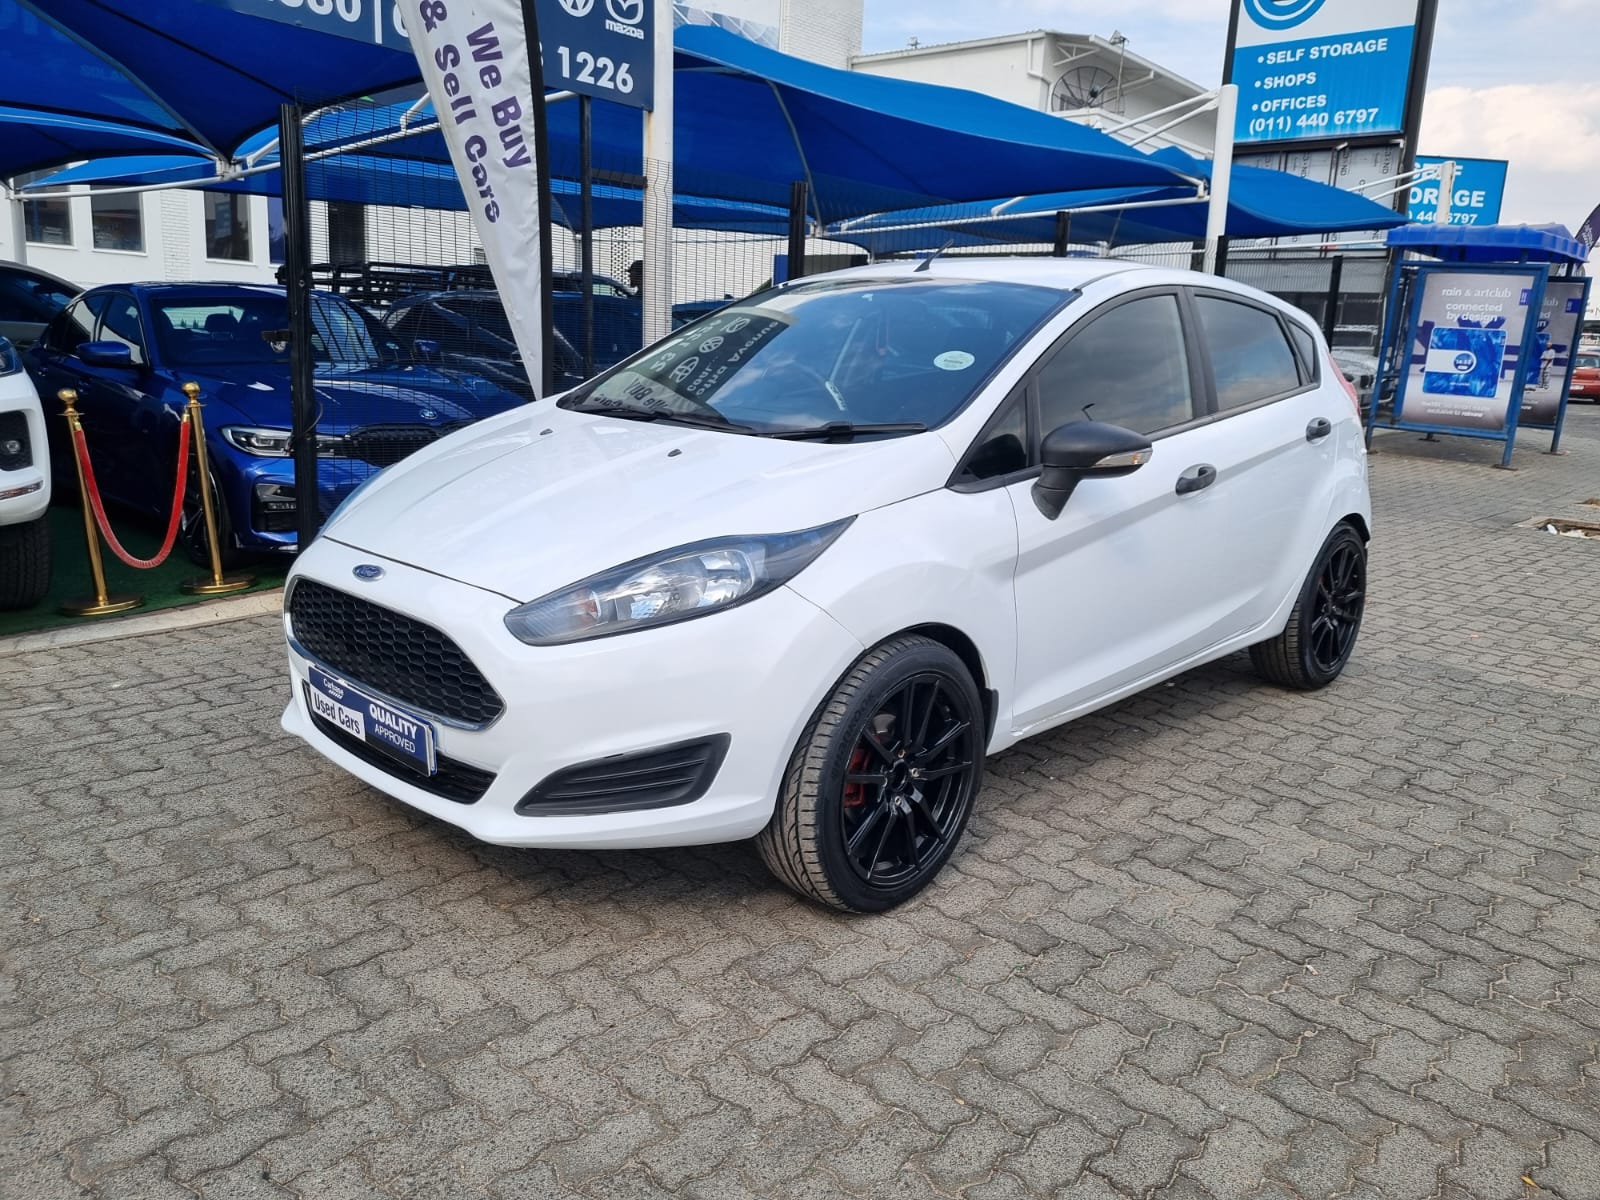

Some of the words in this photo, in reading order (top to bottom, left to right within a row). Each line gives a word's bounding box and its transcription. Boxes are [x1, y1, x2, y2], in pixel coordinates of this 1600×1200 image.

[605, 18, 645, 40] mazda
[1266, 48, 1305, 65] SELF
[1309, 38, 1388, 60] STORAGE
[556, 45, 634, 94] 1226
[1263, 72, 1317, 89] SHOPS
[466, 21, 503, 89] We
[491, 95, 531, 168] Buy
[1260, 94, 1327, 112] OFFICES
[419, 0, 447, 34] &
[434, 43, 477, 125] Sell
[464, 134, 500, 223] Cars
[1249, 115, 1291, 134] (011)
[1296, 112, 1329, 128] 440
[1334, 108, 1379, 125] 6797
[1442, 288, 1462, 297] rain
[1446, 303, 1503, 313] connected
[1446, 311, 1459, 321] by
[1461, 311, 1498, 323] design
[314, 691, 336, 721] Used
[338, 706, 361, 735] Cars
[369, 703, 418, 739] QUALITY
[375, 724, 416, 753] APPROVED
